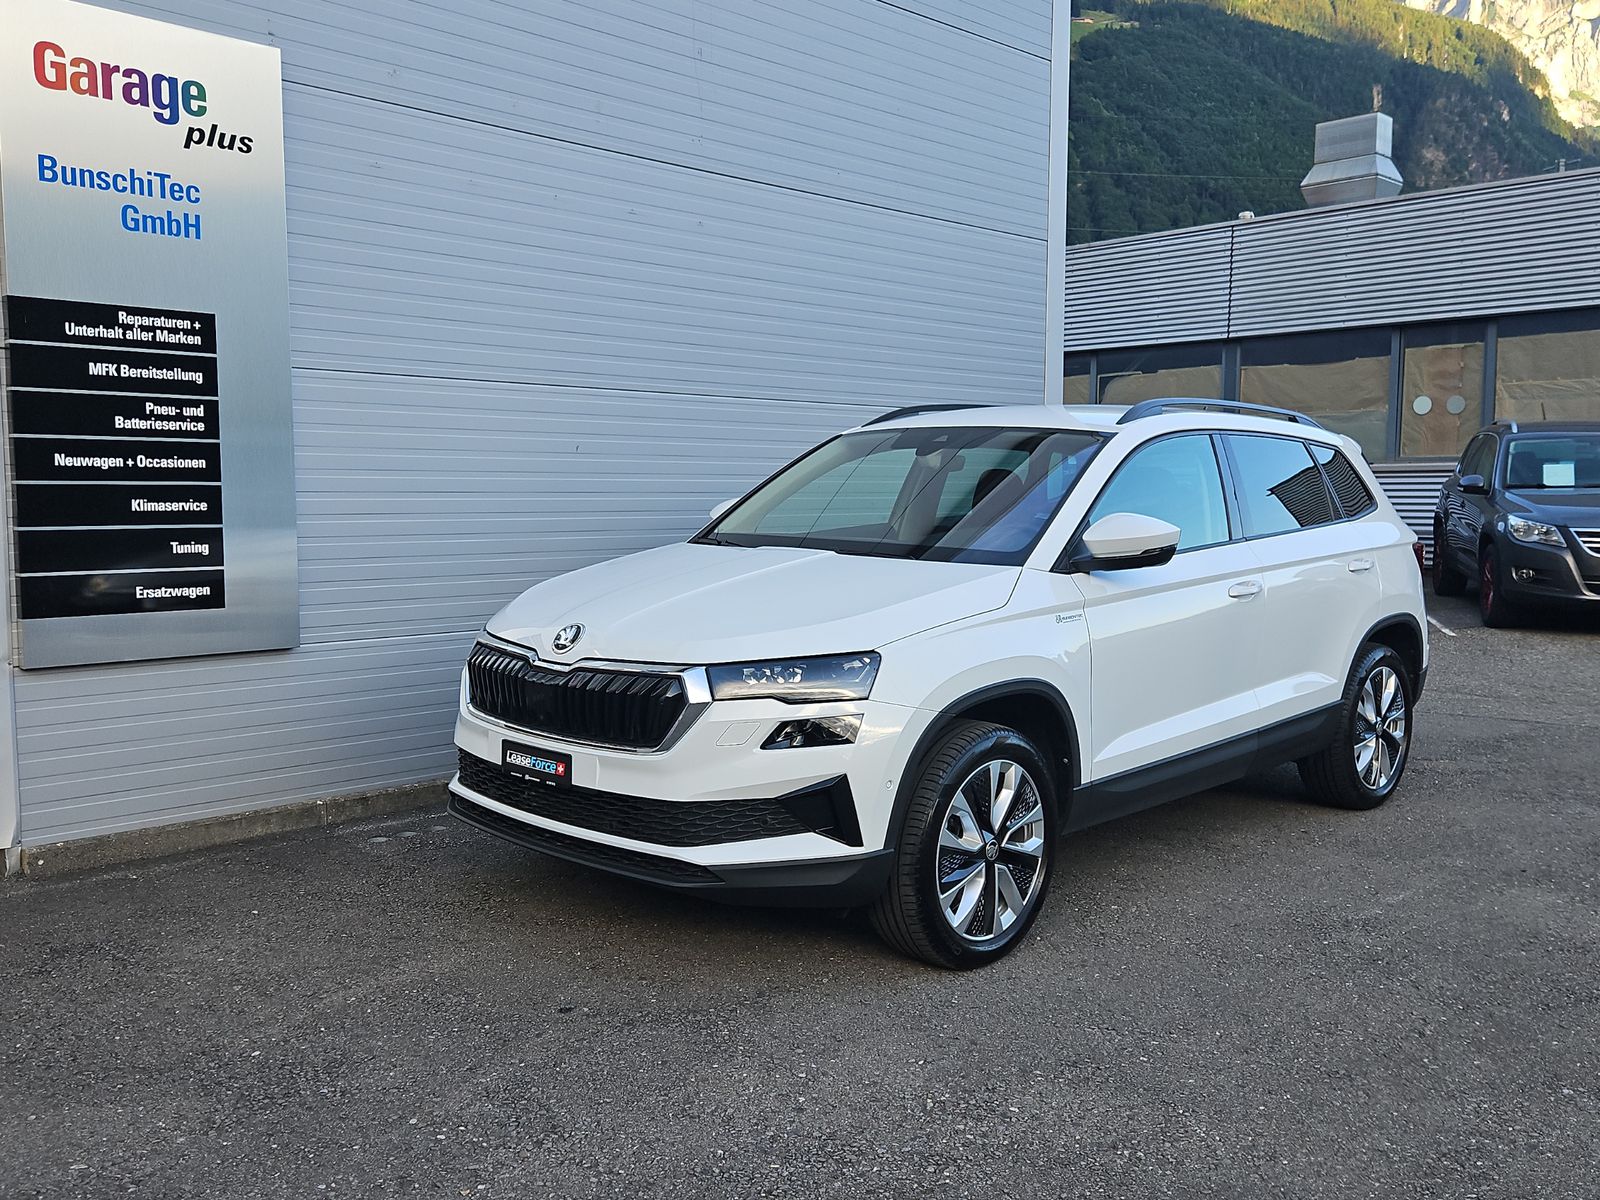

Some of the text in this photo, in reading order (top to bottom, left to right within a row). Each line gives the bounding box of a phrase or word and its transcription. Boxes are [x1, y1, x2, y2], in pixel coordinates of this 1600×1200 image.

[33, 41, 207, 125] Garage
[183, 124, 254, 154] plus
[37, 154, 201, 204] BunschiTec
[121, 204, 201, 240] GmbH
[118, 311, 191, 329] Reparaturen
[65, 322, 201, 345] Unterhalt aller Marken
[88, 362, 203, 384] MFK Bereitstellung
[145, 402, 204, 417] Pneu- und
[114, 416, 205, 431] Batterieservice
[54, 453, 124, 469] Neuwagen
[136, 455, 206, 469] Occasionen
[131, 499, 208, 512] Klimaservice
[170, 541, 209, 555] Tuning
[135, 585, 210, 599] Ersatzwagen
[506, 750, 557, 772] LeaseForce
